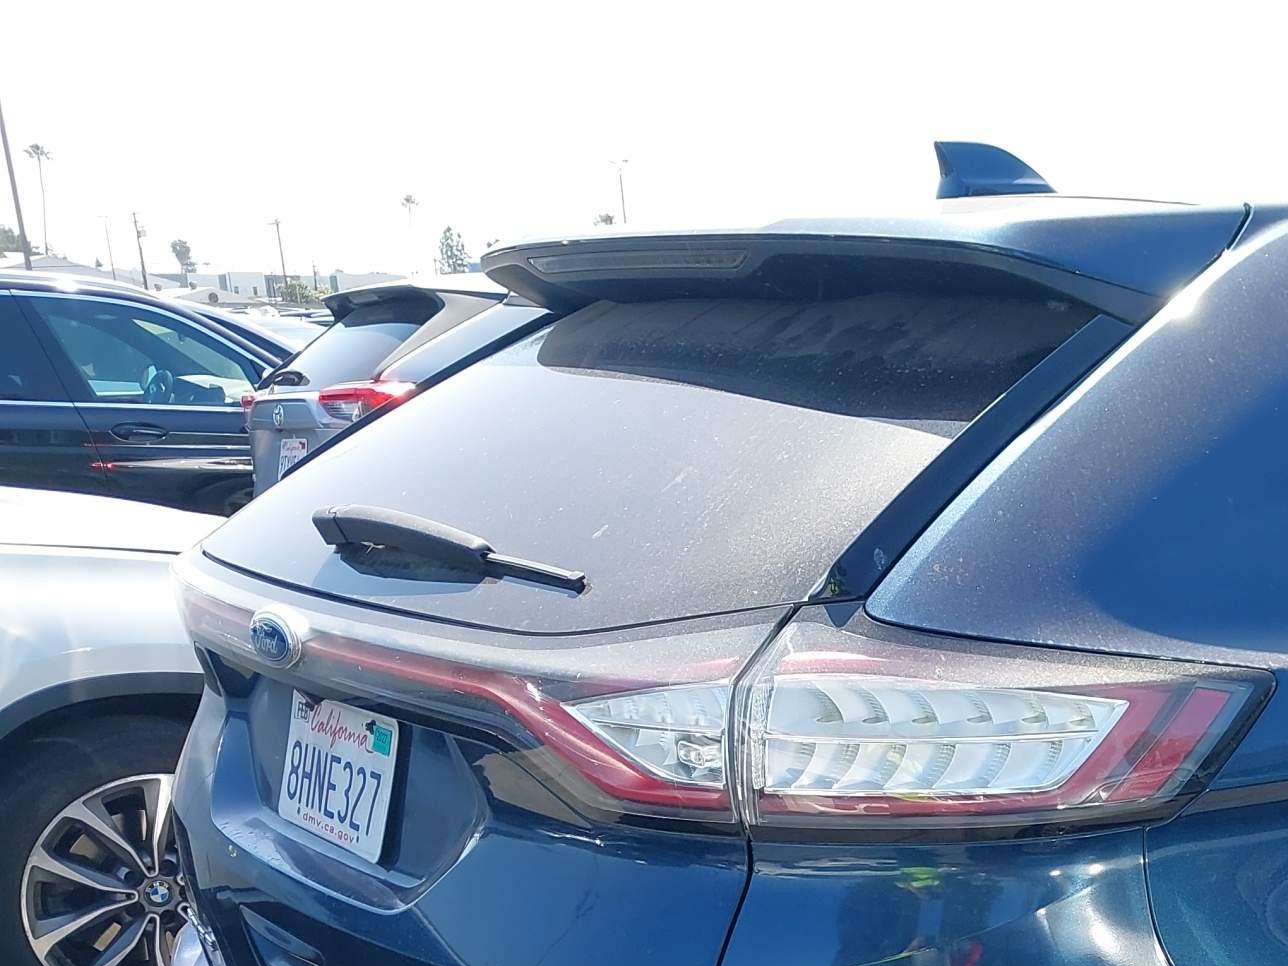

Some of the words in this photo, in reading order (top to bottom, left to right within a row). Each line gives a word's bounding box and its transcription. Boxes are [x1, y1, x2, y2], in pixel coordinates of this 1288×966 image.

[310, 705, 373, 754] California
[286, 740, 382, 837] 8HNE327
[302, 812, 355, 845] dmv.ca.gov
